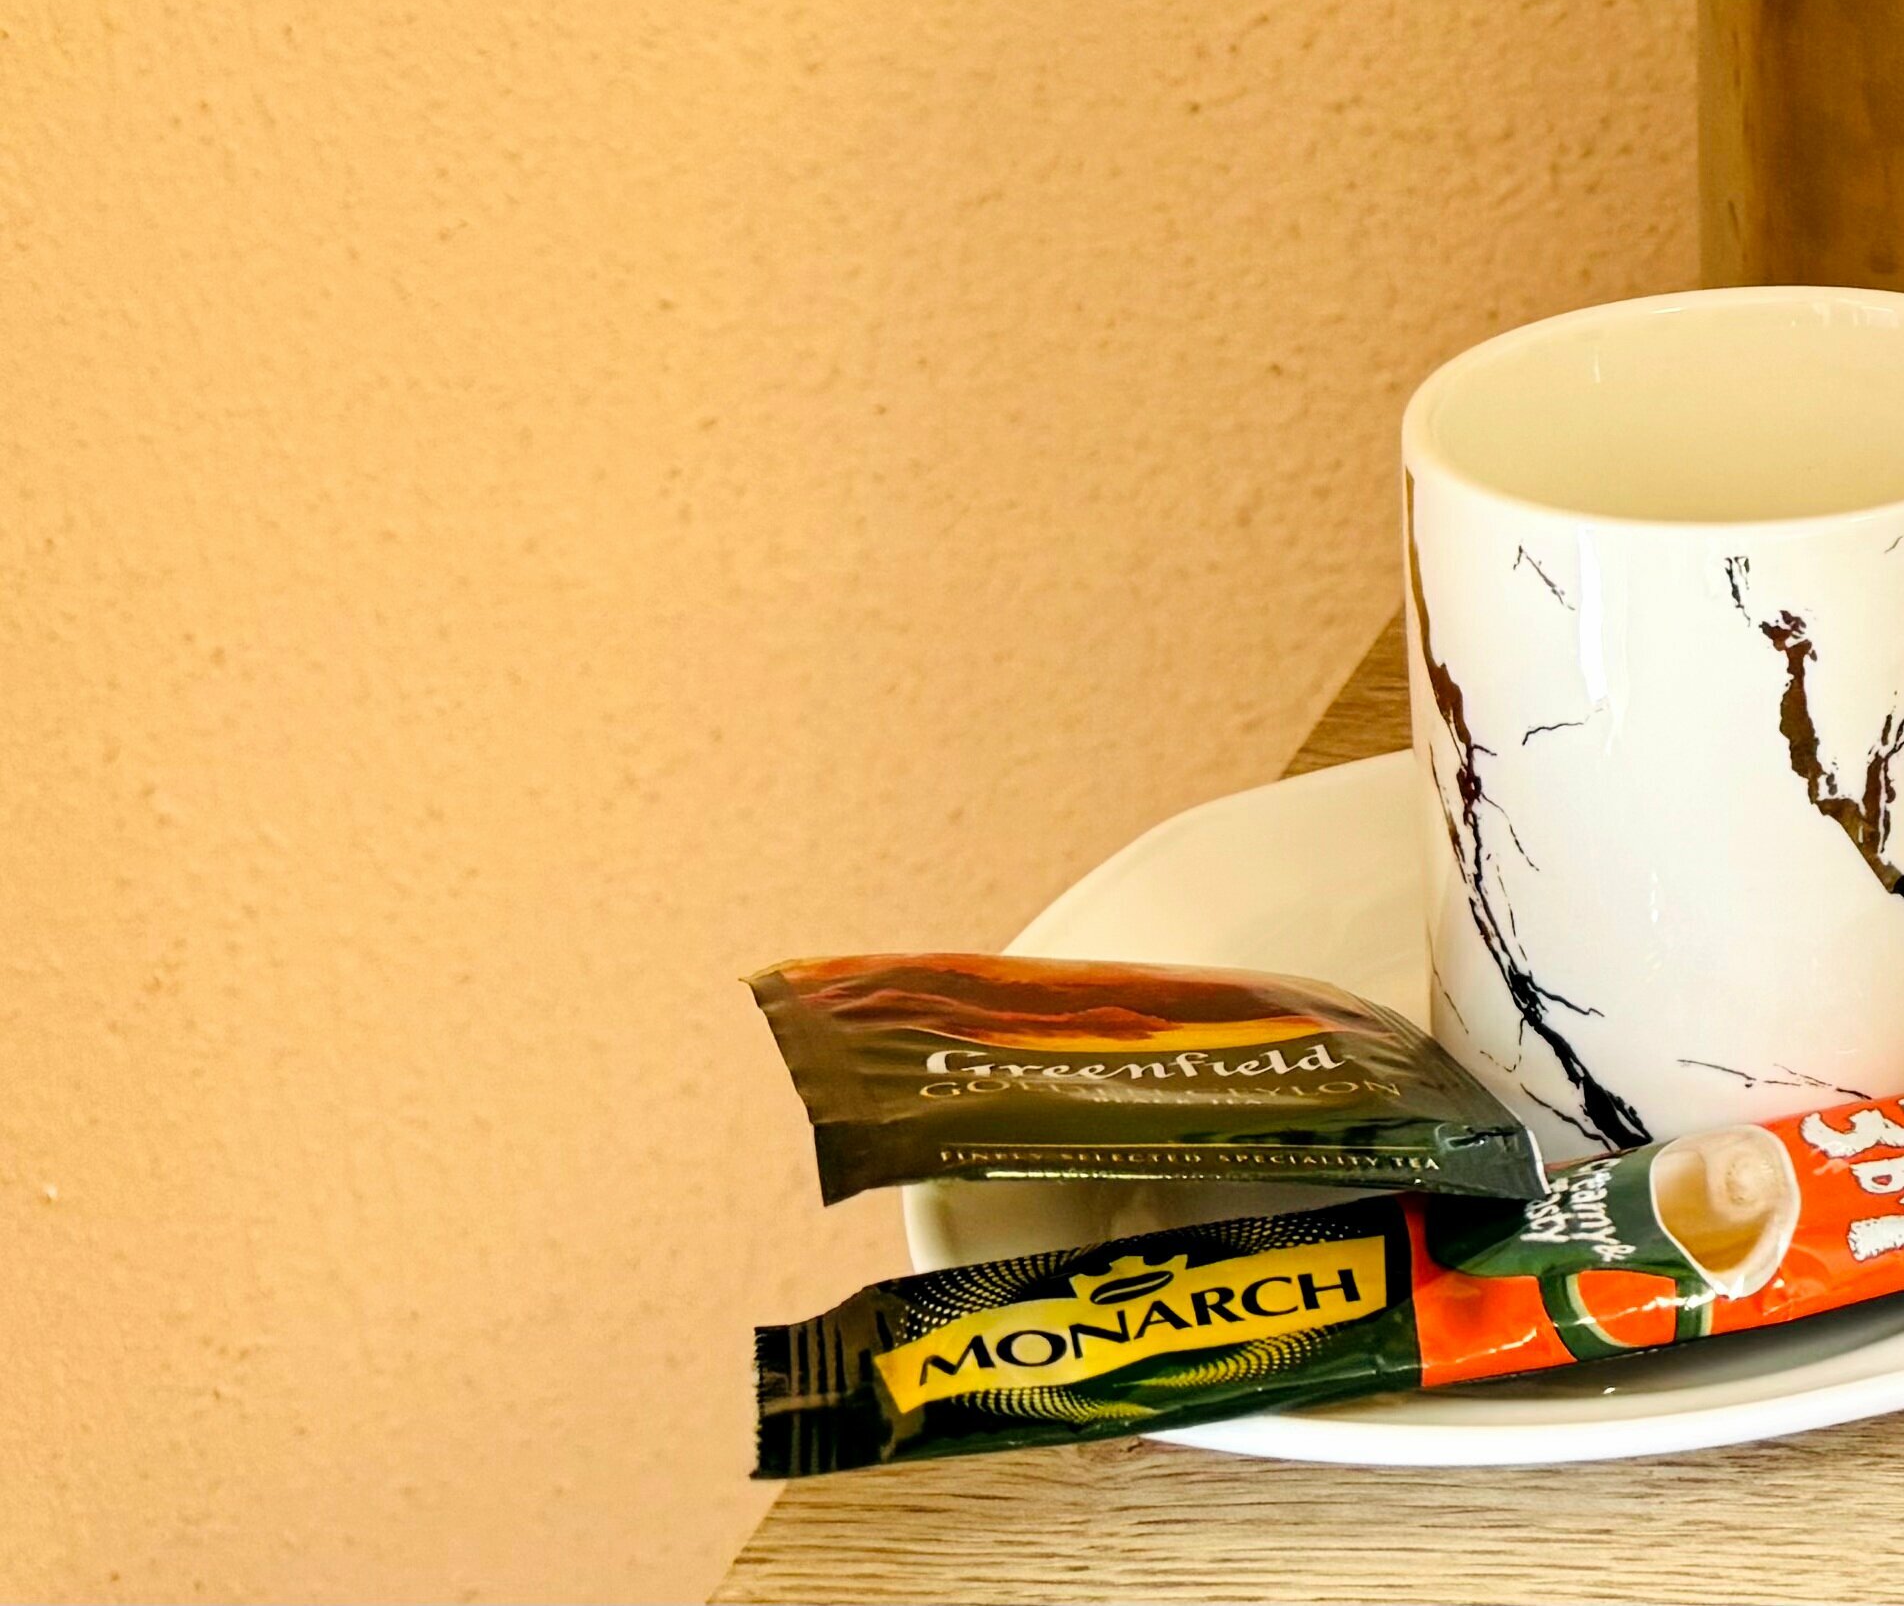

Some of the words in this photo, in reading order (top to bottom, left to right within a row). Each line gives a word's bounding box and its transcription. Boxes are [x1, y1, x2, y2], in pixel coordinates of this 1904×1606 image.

[926, 1044, 1347, 1080] Greenfield
[1218, 1153, 1379, 1167] SPECIALITY
[1390, 1157, 1440, 1170] TEA
[917, 1267, 1364, 1386] MONARCH
